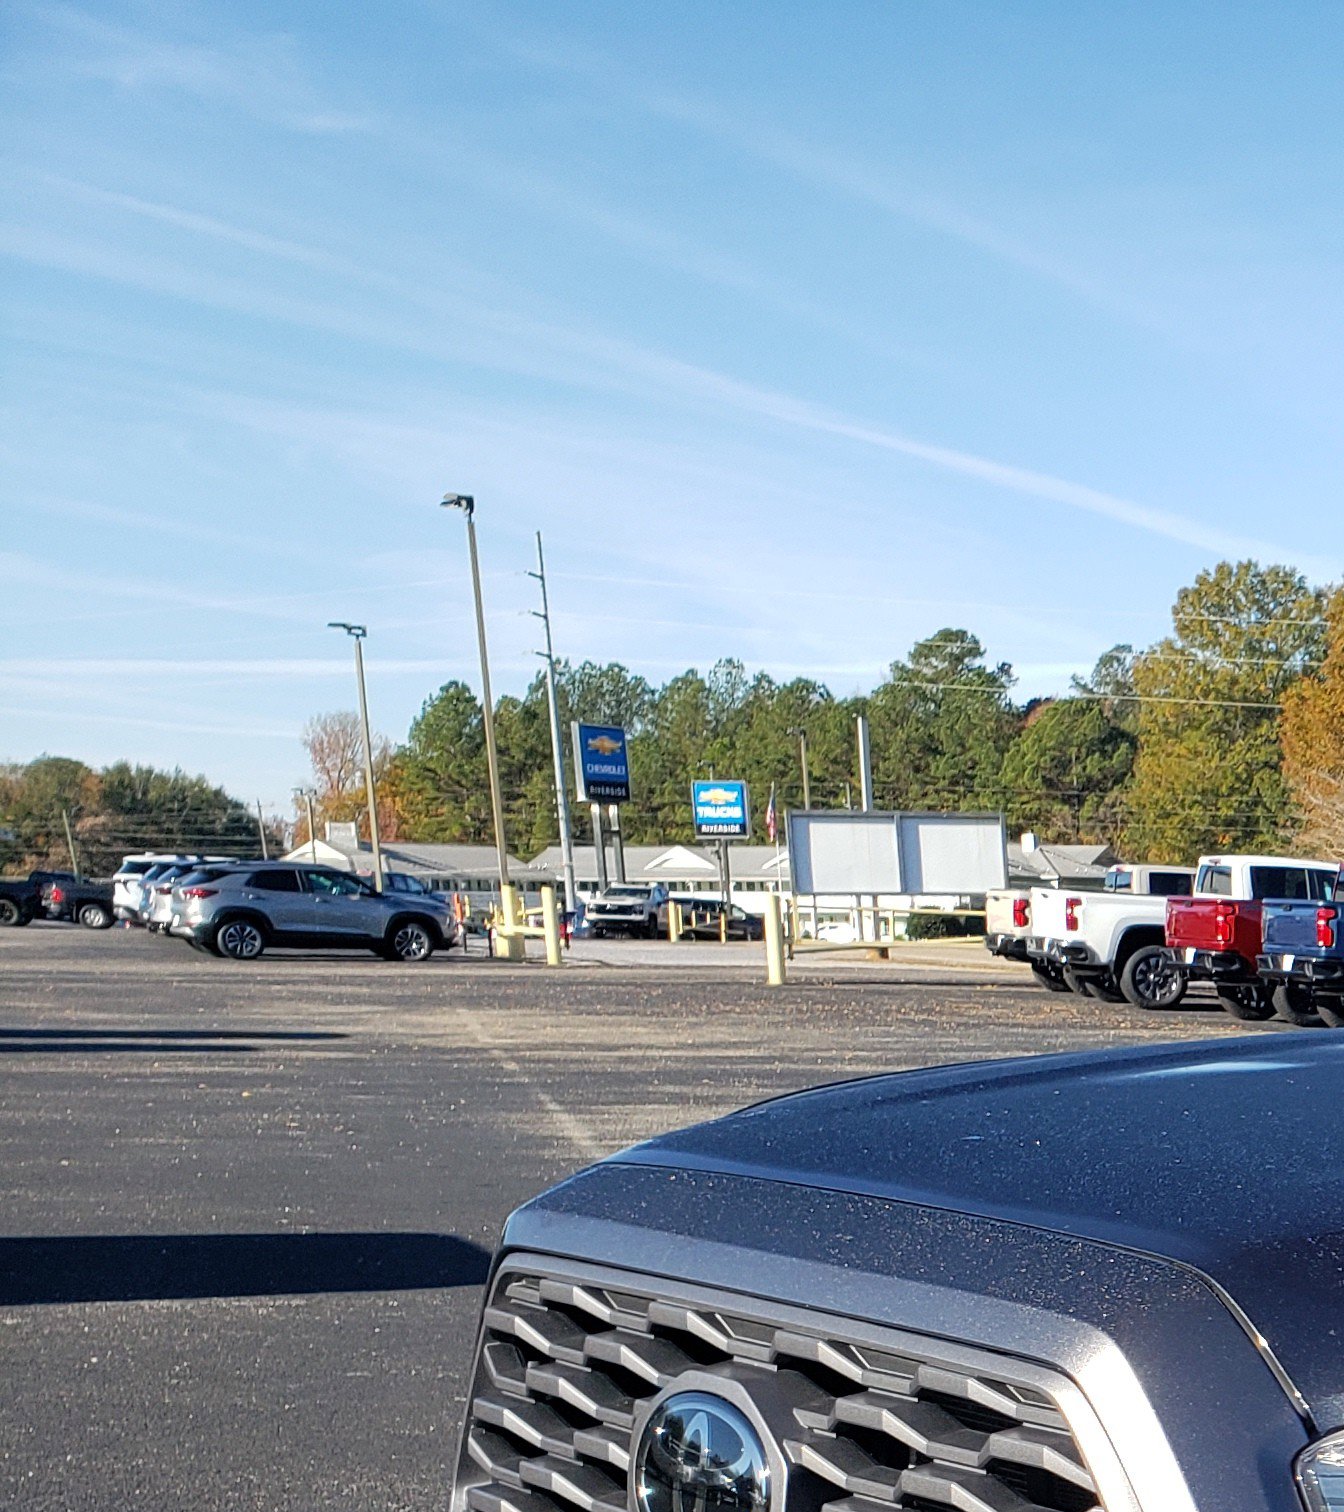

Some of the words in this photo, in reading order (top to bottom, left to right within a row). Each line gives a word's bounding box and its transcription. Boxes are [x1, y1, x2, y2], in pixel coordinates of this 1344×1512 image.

[589, 784, 626, 796] RIVERSIDE
[696, 806, 742, 819] TRUCKS
[700, 823, 741, 833] RIVERSIDE
